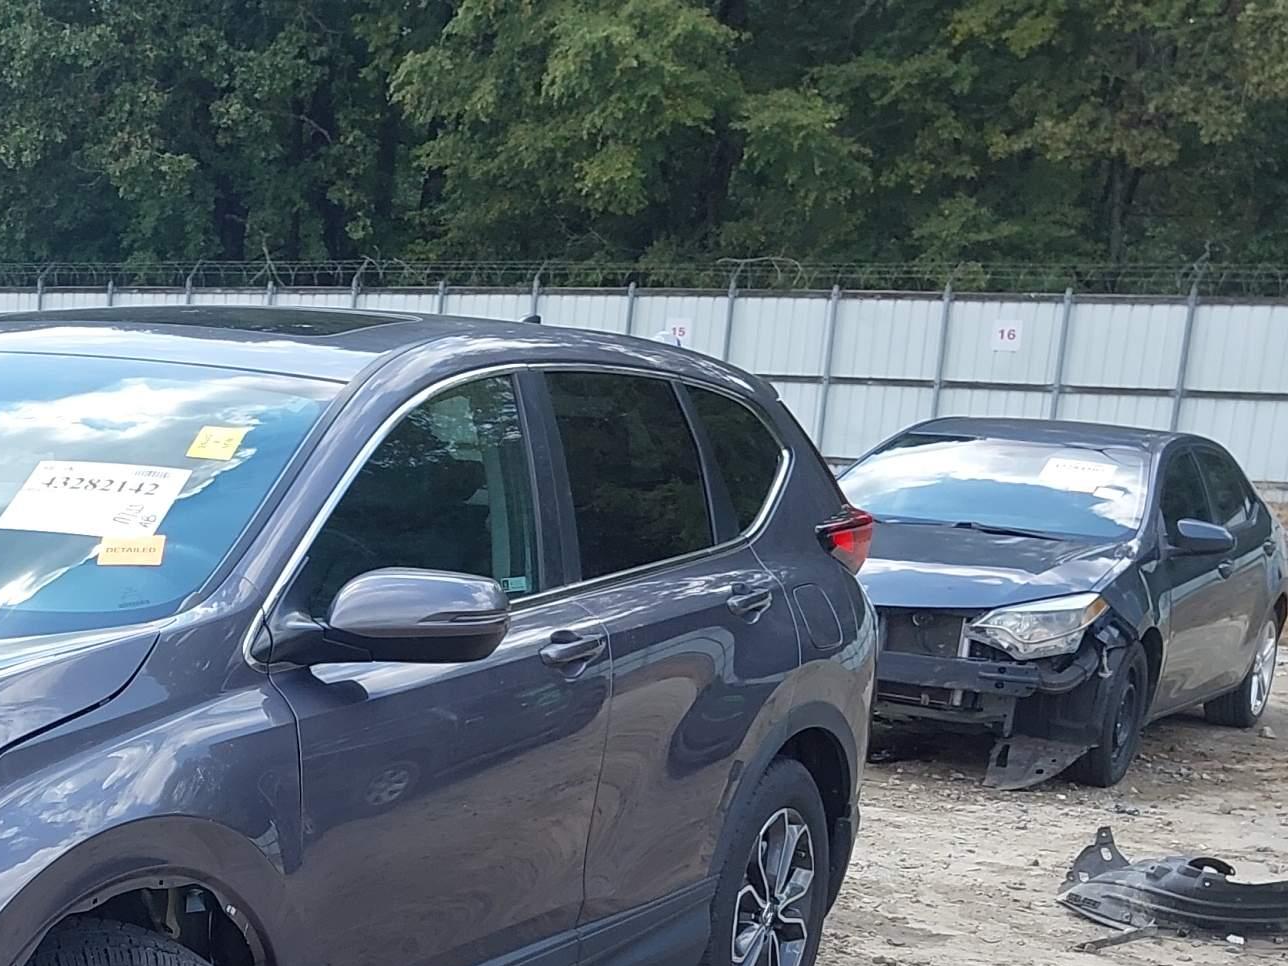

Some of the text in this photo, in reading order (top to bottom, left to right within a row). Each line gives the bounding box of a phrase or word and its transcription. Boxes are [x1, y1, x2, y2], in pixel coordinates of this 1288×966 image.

[671, 326, 687, 337] 15
[997, 328, 1017, 341] 16
[41, 475, 161, 497] 43282142
[105, 545, 158, 554] DETAILED
